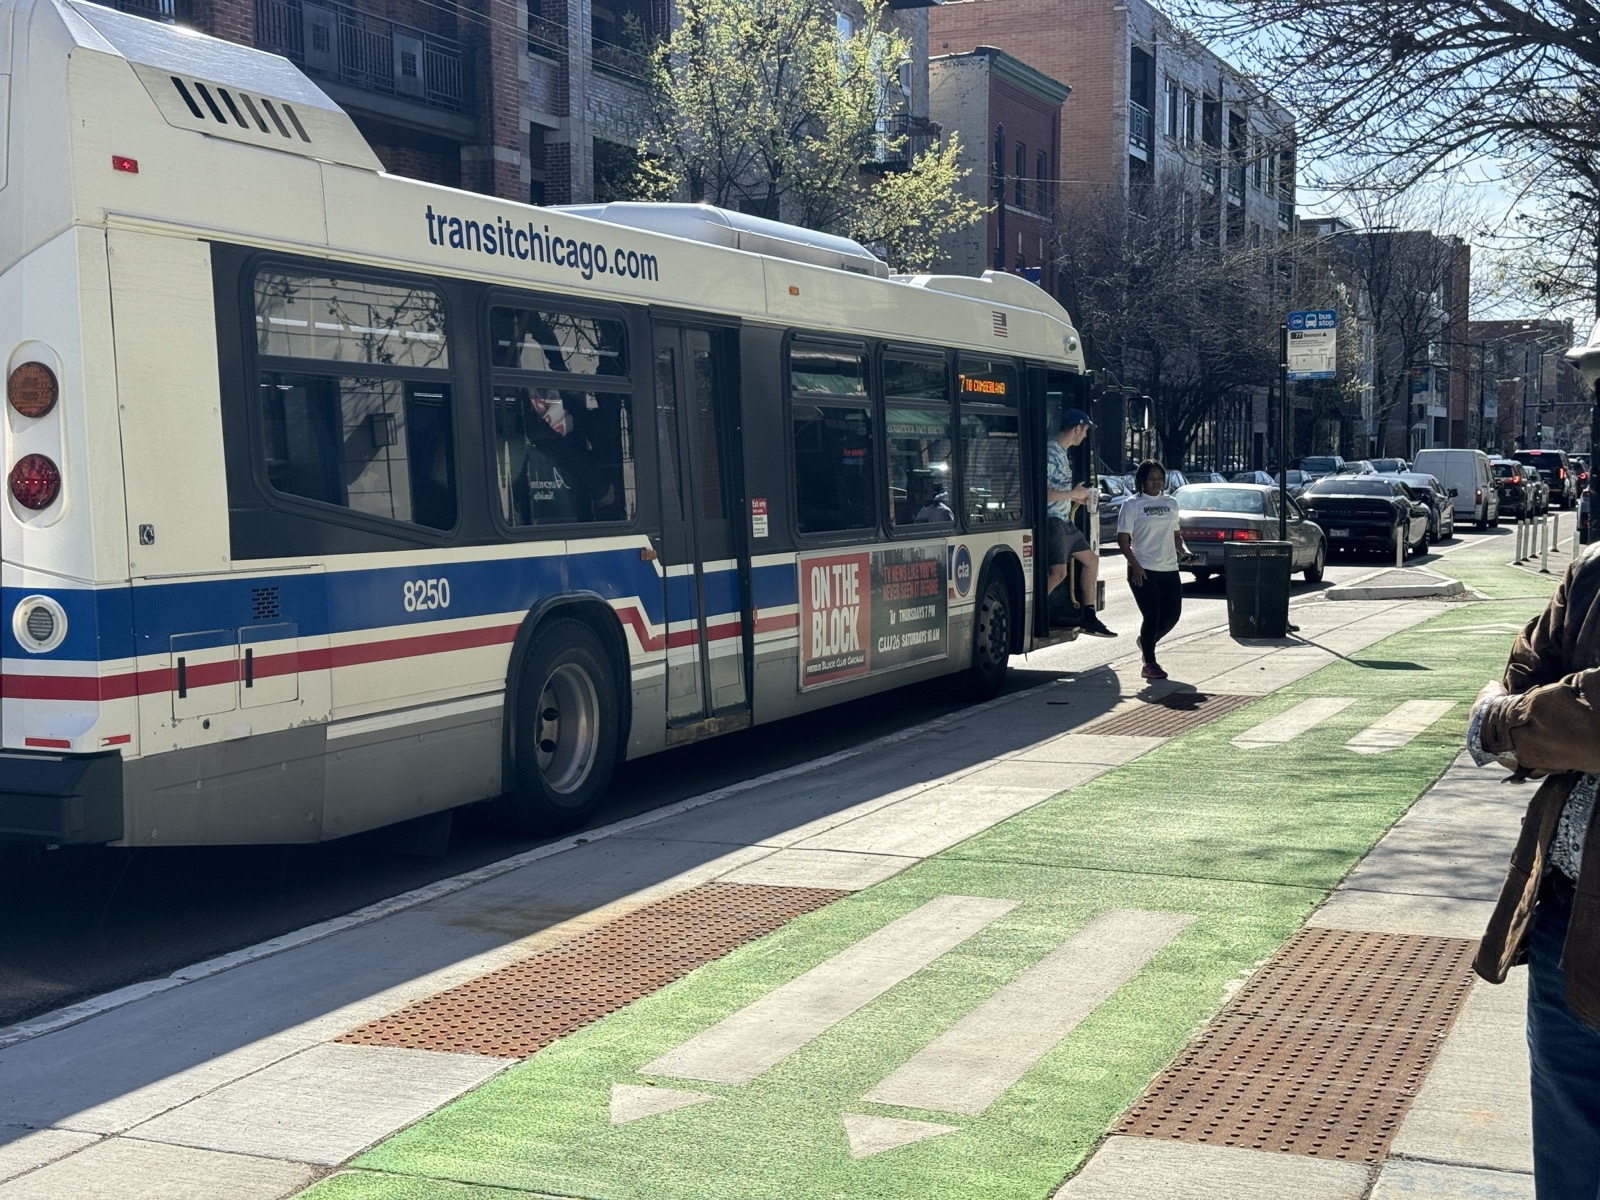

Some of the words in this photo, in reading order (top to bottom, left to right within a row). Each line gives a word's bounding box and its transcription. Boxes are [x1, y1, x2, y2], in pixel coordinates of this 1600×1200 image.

[425, 205, 659, 281] transitchicago.com
[811, 565, 831, 611] ON
[832, 562, 860, 607] THE
[957, 561, 969, 579] cta
[403, 577, 451, 612] 8250
[899, 605, 924, 623] THURSDAYS
[928, 604, 936, 618] PM
[811, 605, 861, 659] BLOCK
[901, 629, 927, 648] SATURDAYS
[932, 627, 940, 641] AM
